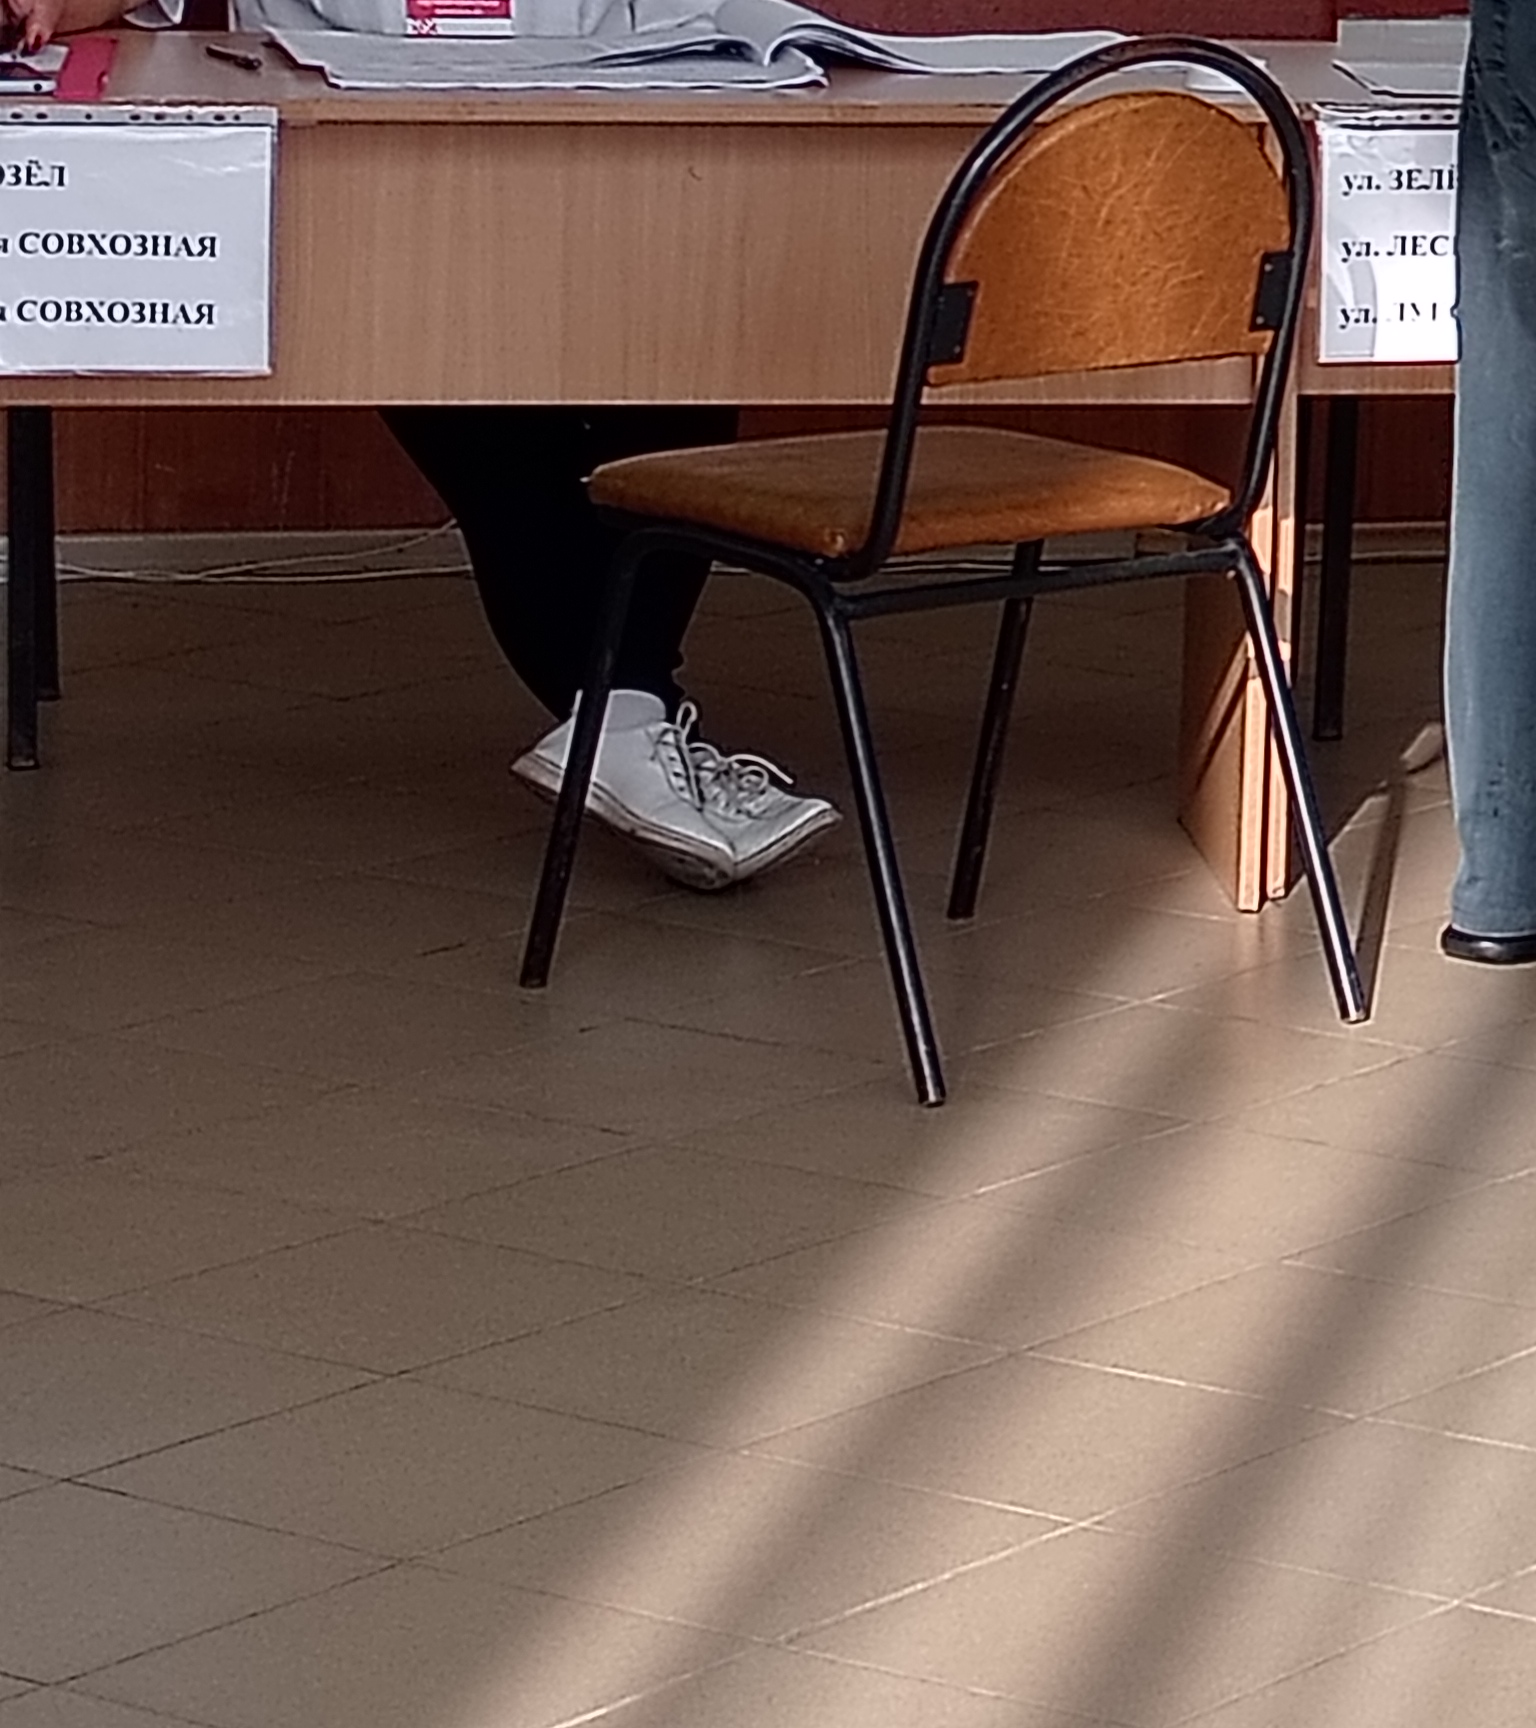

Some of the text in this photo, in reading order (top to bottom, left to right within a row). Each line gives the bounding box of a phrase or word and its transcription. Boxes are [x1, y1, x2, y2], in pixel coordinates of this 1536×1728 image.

[0, 159, 66, 187] ЗЁЛ
[1342, 174, 1382, 197] ул.
[18, 232, 218, 258] СОВХОЗНАЯ
[1340, 234, 1456, 264] ул. ЛЕС
[16, 298, 216, 325] СОВХОЗНАЯ
[1338, 307, 1378, 330] ул.
